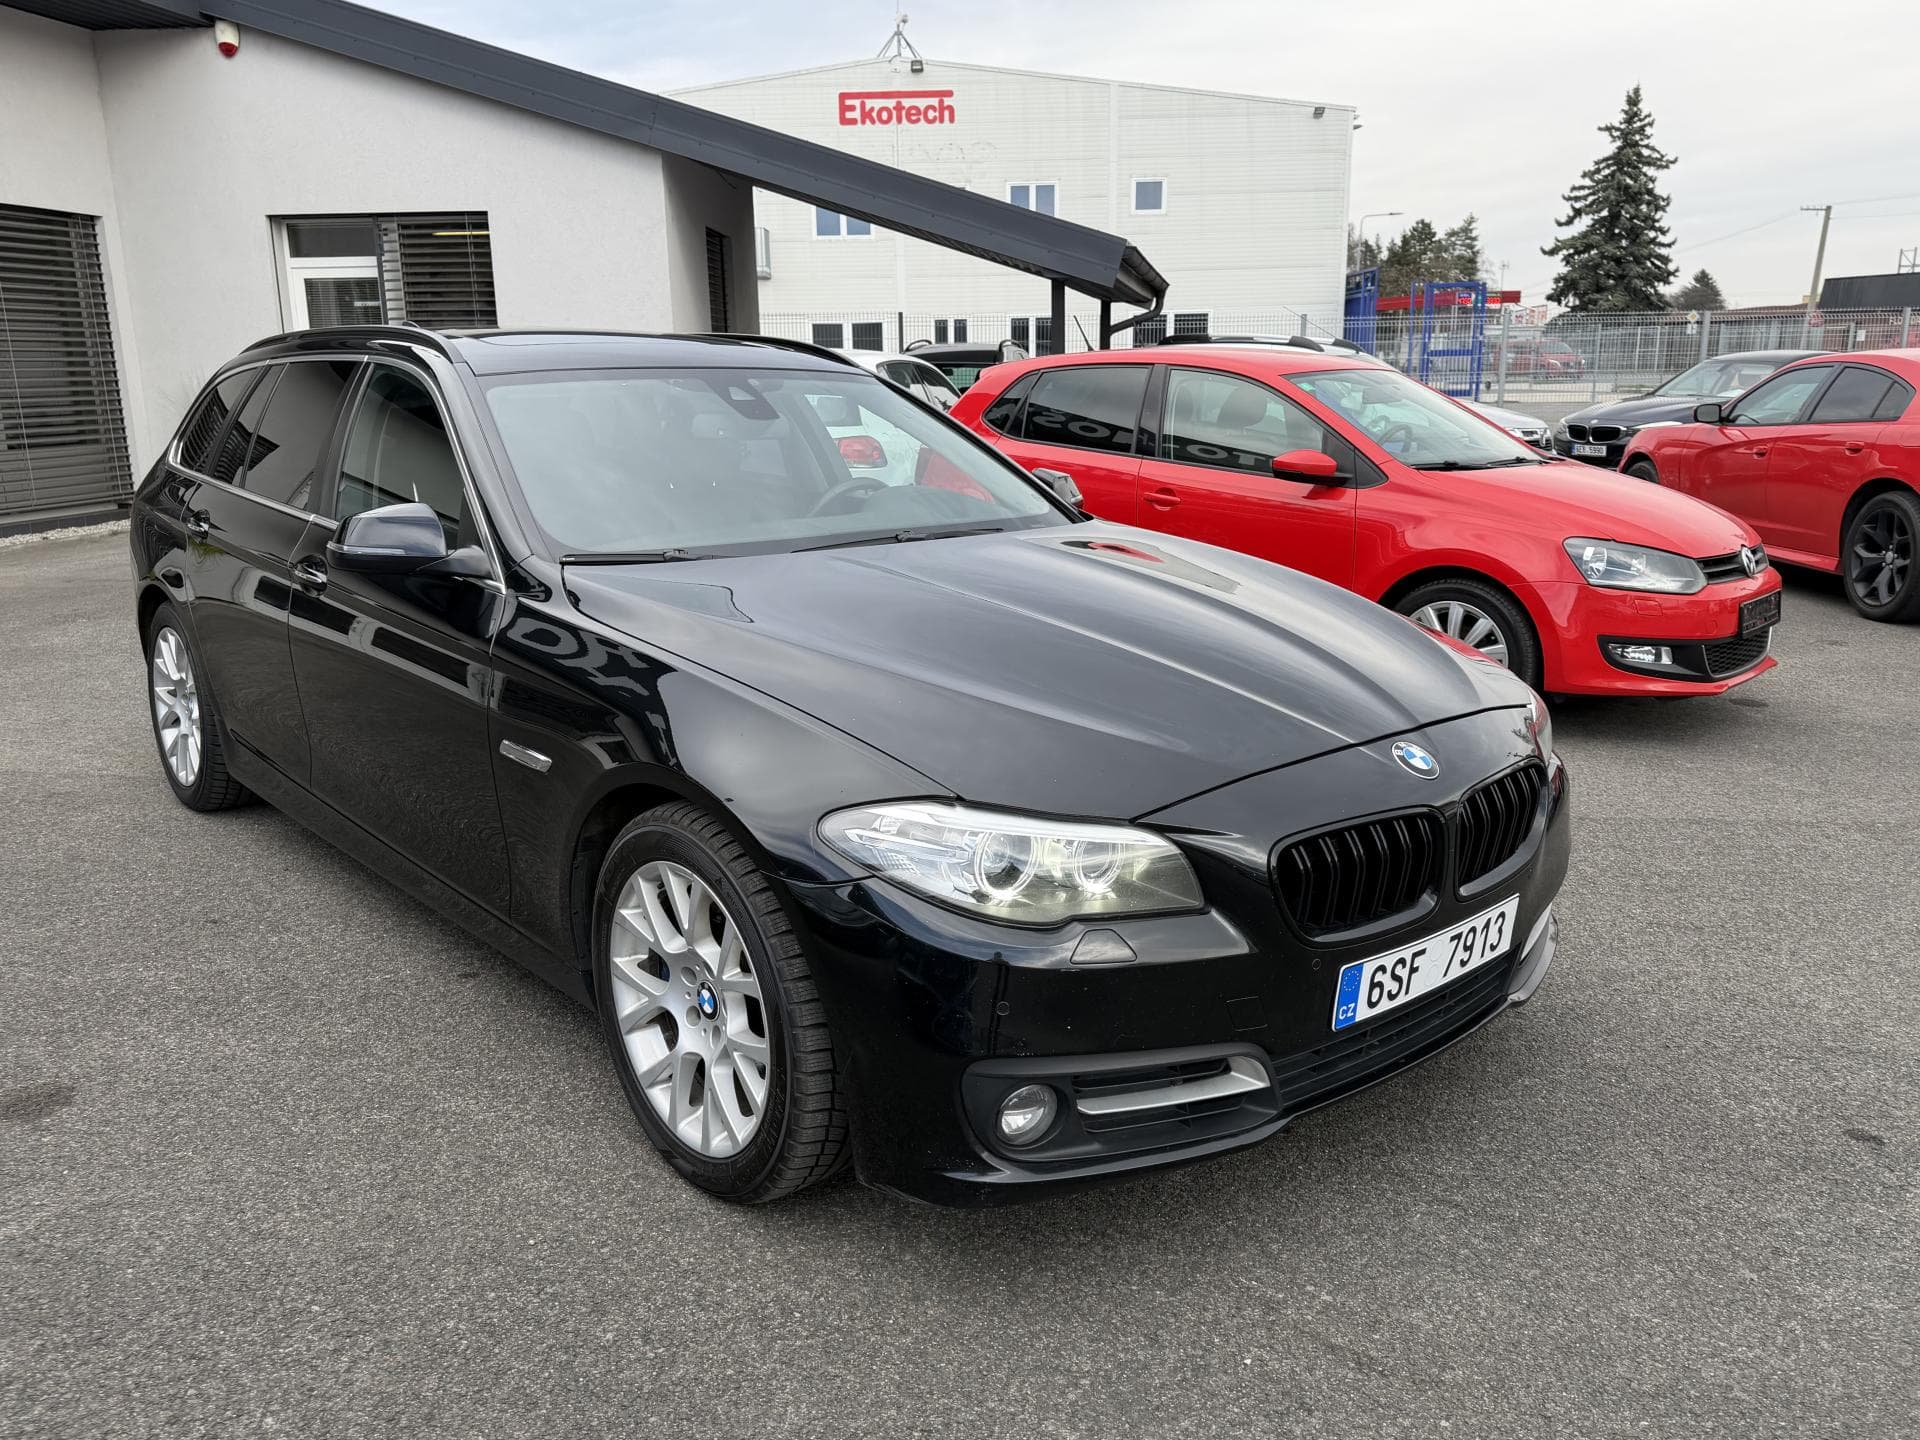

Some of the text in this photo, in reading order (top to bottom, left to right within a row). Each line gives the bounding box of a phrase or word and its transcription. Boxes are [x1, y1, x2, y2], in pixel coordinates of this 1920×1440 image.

[838, 90, 955, 126] Ekotech
[1366, 910, 1506, 1009] 6SF 7913
[1338, 1002, 1356, 1020] CZ
